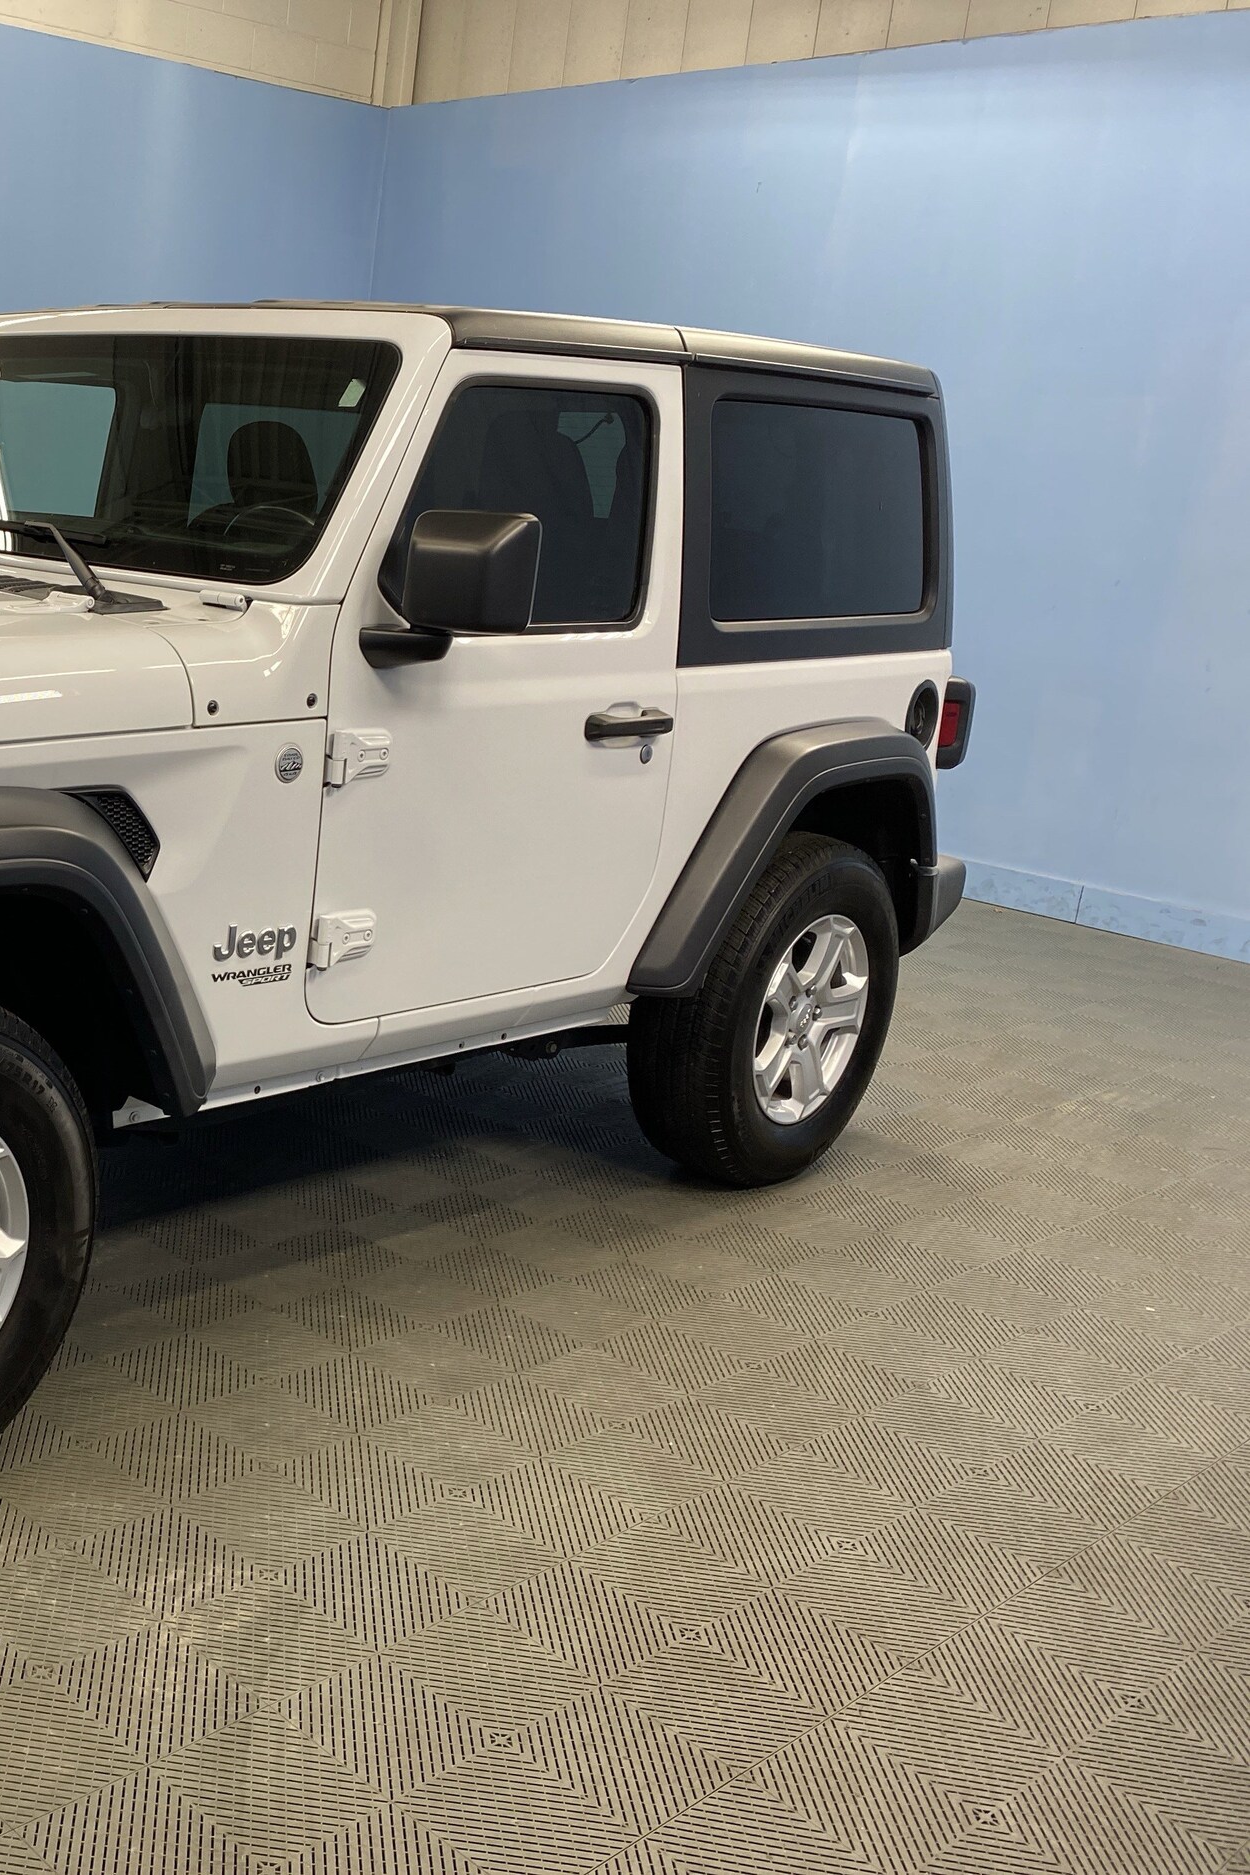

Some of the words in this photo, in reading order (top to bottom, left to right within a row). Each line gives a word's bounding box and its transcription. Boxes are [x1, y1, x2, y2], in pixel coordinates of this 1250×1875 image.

[213, 923, 297, 962] Jeep
[211, 963, 292, 982] WRANGLER
[240, 974, 290, 986] SPORT
